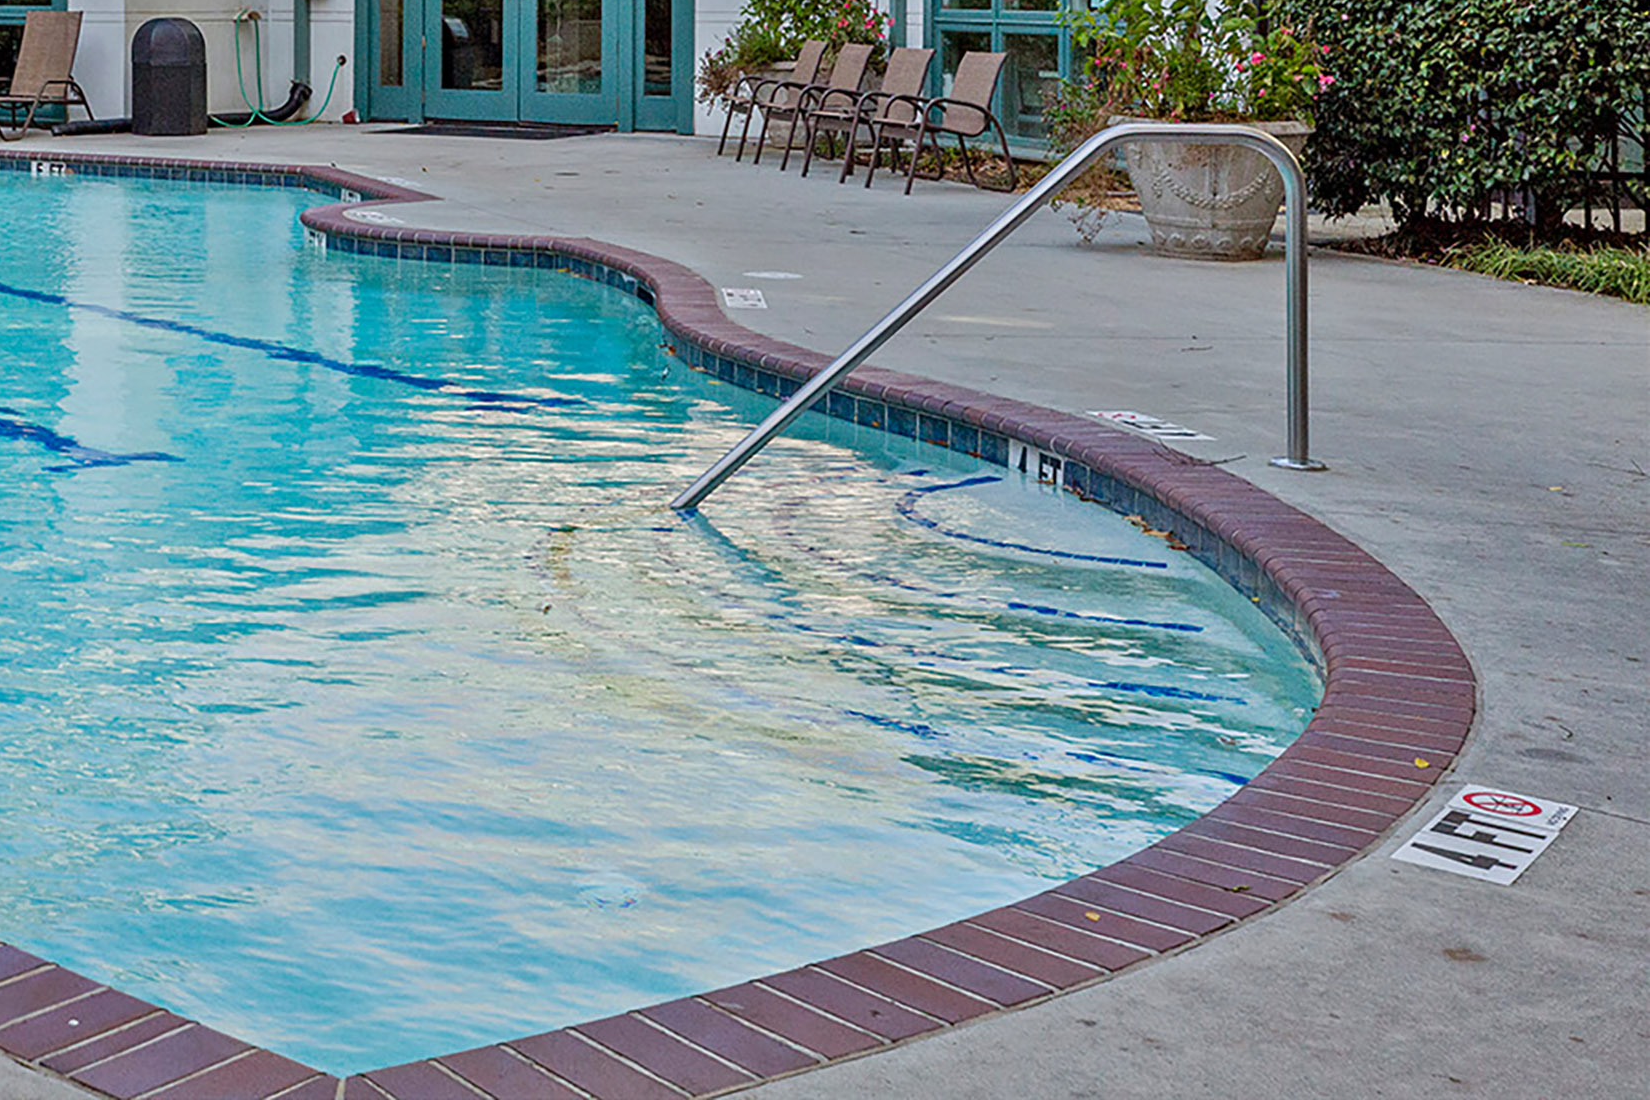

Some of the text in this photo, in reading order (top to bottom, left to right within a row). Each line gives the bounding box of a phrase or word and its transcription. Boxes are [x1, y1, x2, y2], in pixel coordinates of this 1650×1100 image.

[1038, 451, 1062, 485] FT
[1429, 809, 1548, 855] FT
[1410, 841, 1519, 871] 4
